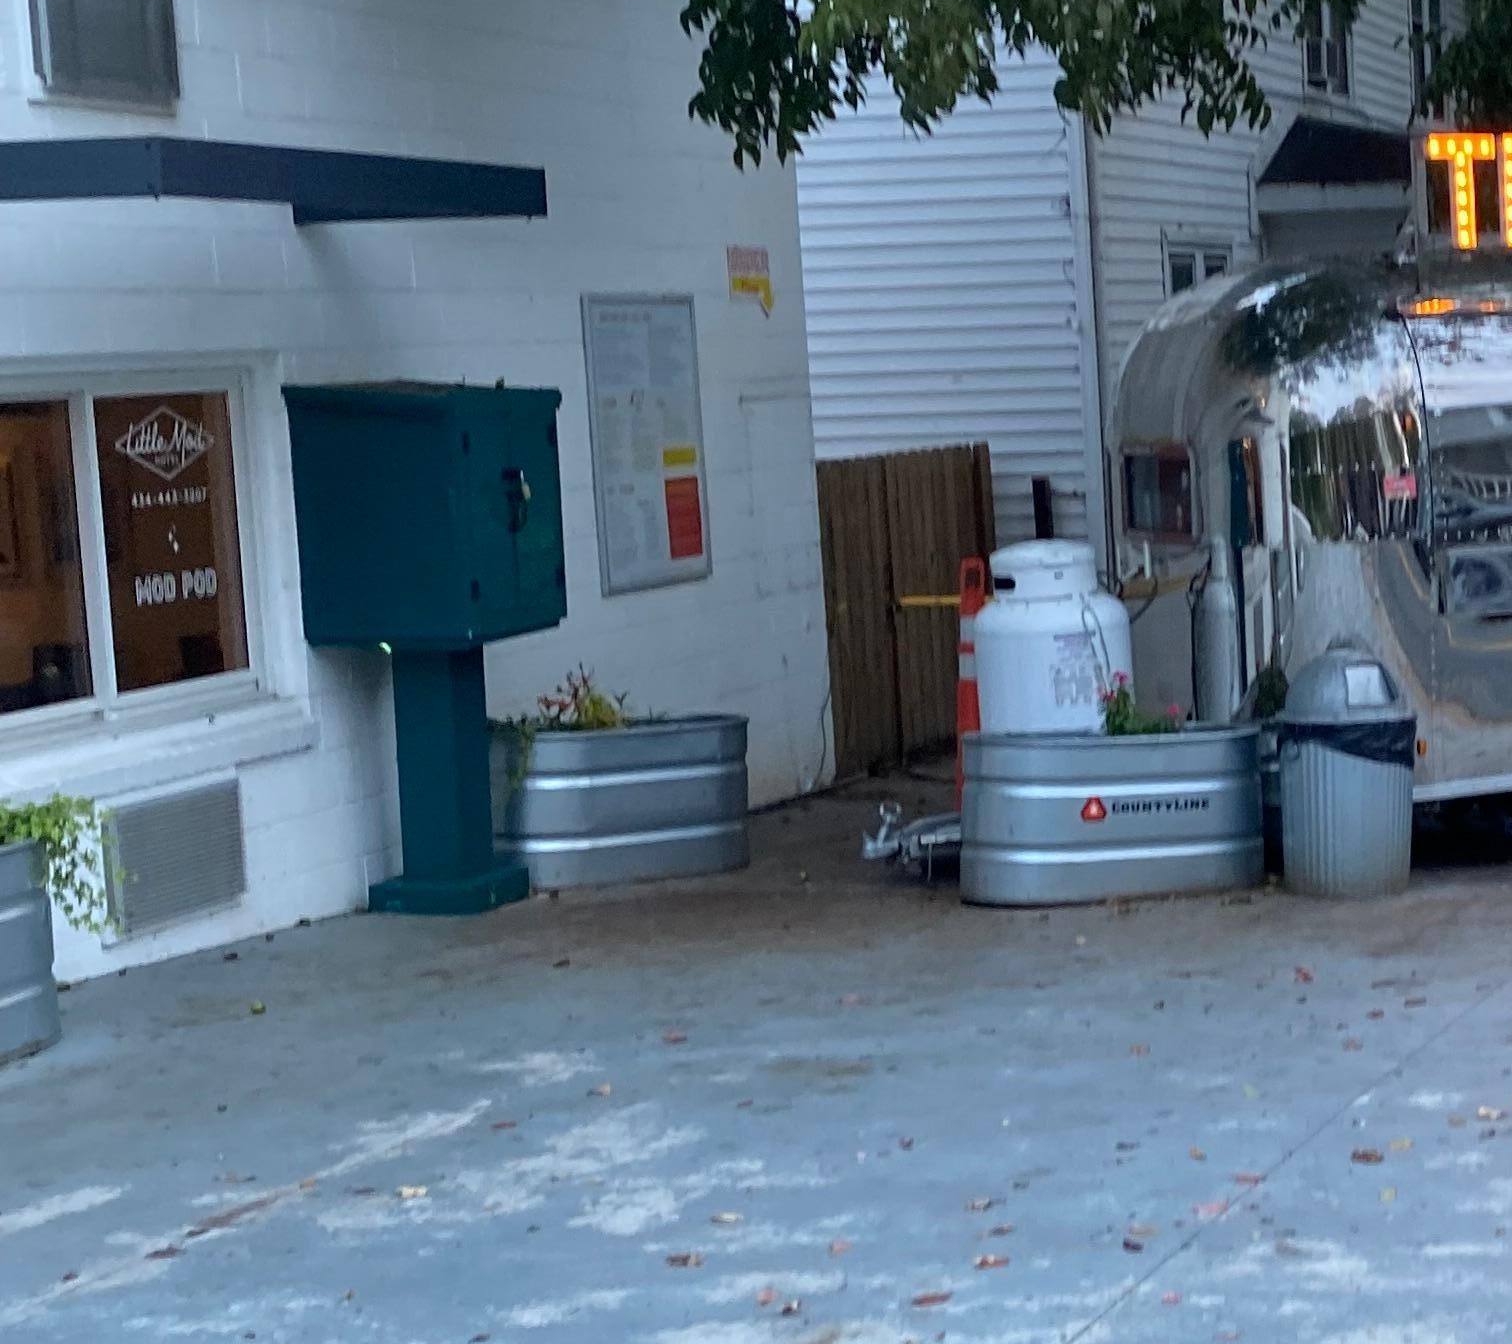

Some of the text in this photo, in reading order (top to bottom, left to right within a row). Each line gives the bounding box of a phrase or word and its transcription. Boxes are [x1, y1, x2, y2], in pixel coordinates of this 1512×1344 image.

[126, 419, 206, 468] Little Mod
[135, 567, 217, 607] MOD POD
